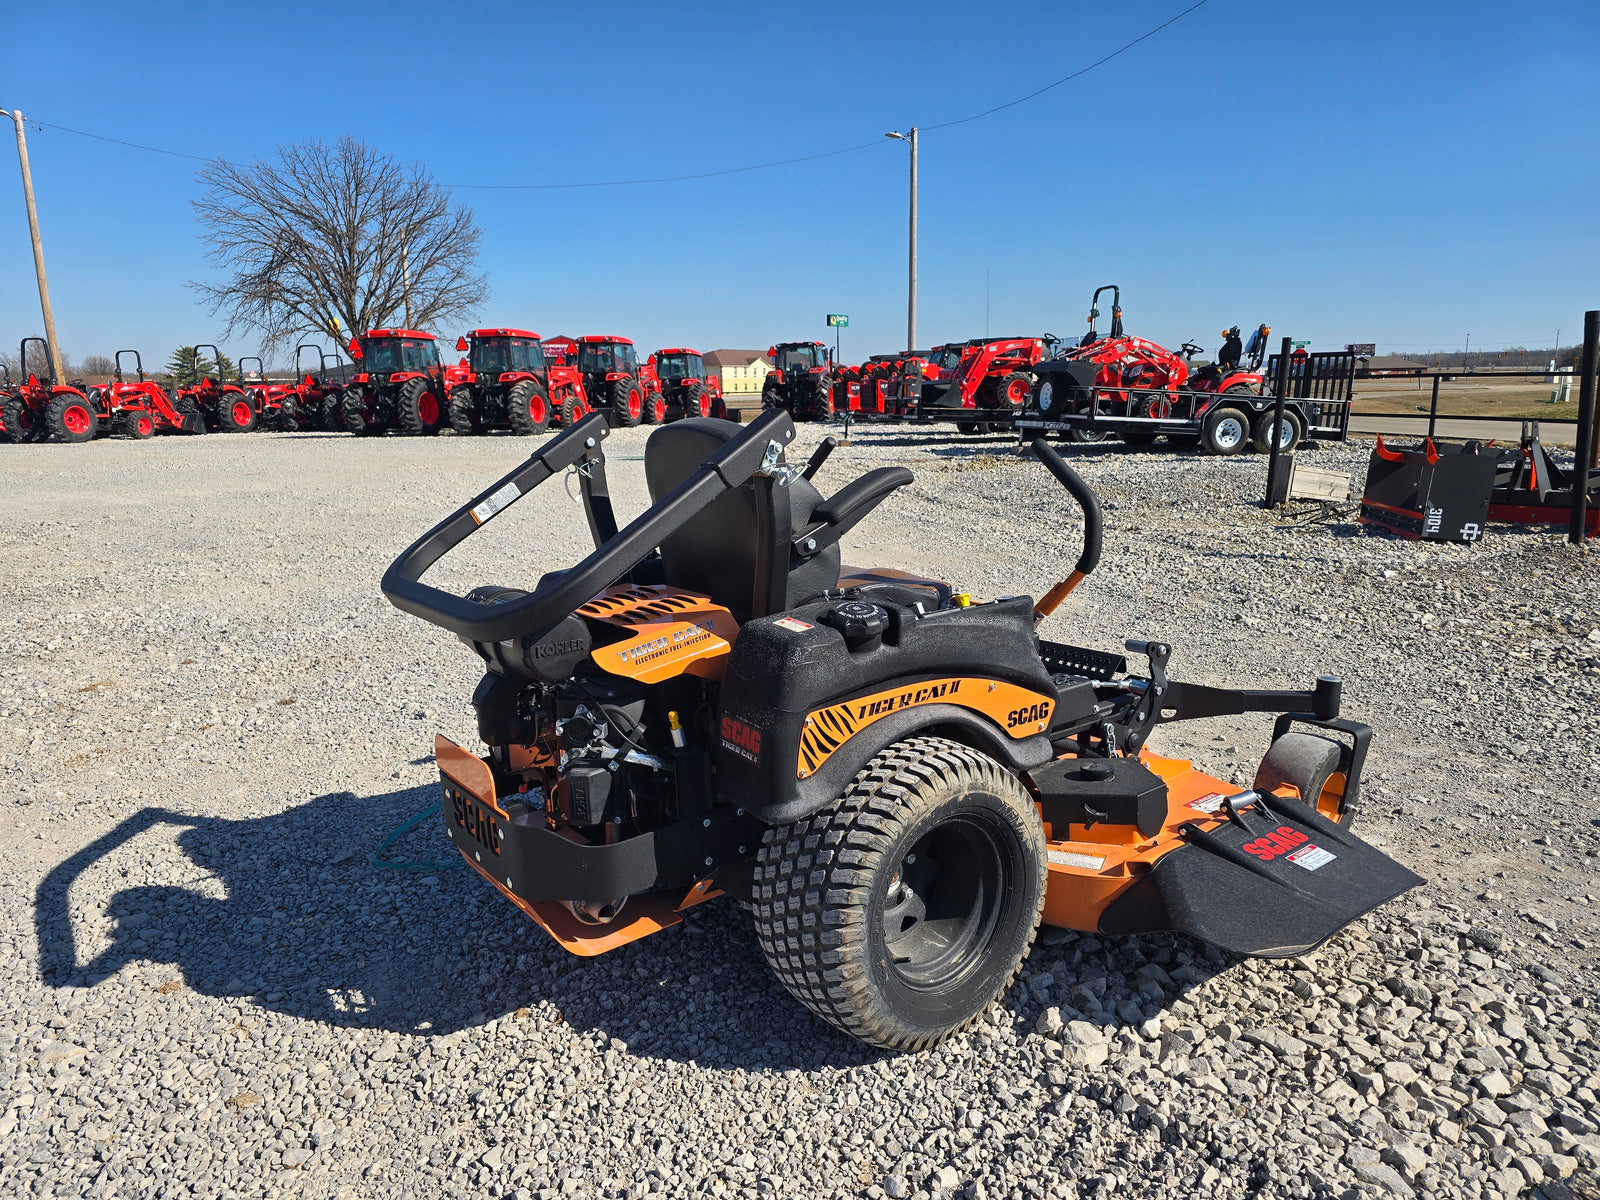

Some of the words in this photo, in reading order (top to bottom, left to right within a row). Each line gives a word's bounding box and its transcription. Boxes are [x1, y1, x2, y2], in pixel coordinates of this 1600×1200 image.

[1426, 507, 1443, 533] 3104
[535, 638, 588, 660] KOHLER
[617, 636, 669, 663] TIGER
[672, 623, 705, 643] CAT
[635, 648, 668, 666] ELECTRONIC
[857, 692, 912, 720] TIGER
[914, 683, 948, 704] CAT
[949, 680, 962, 694] II
[1006, 701, 1050, 729] SCAG
[721, 716, 761, 754] SCAG
[721, 739, 741, 754] TIGER
[452, 789, 501, 857] SCAG
[1242, 826, 1309, 861] SCAG
